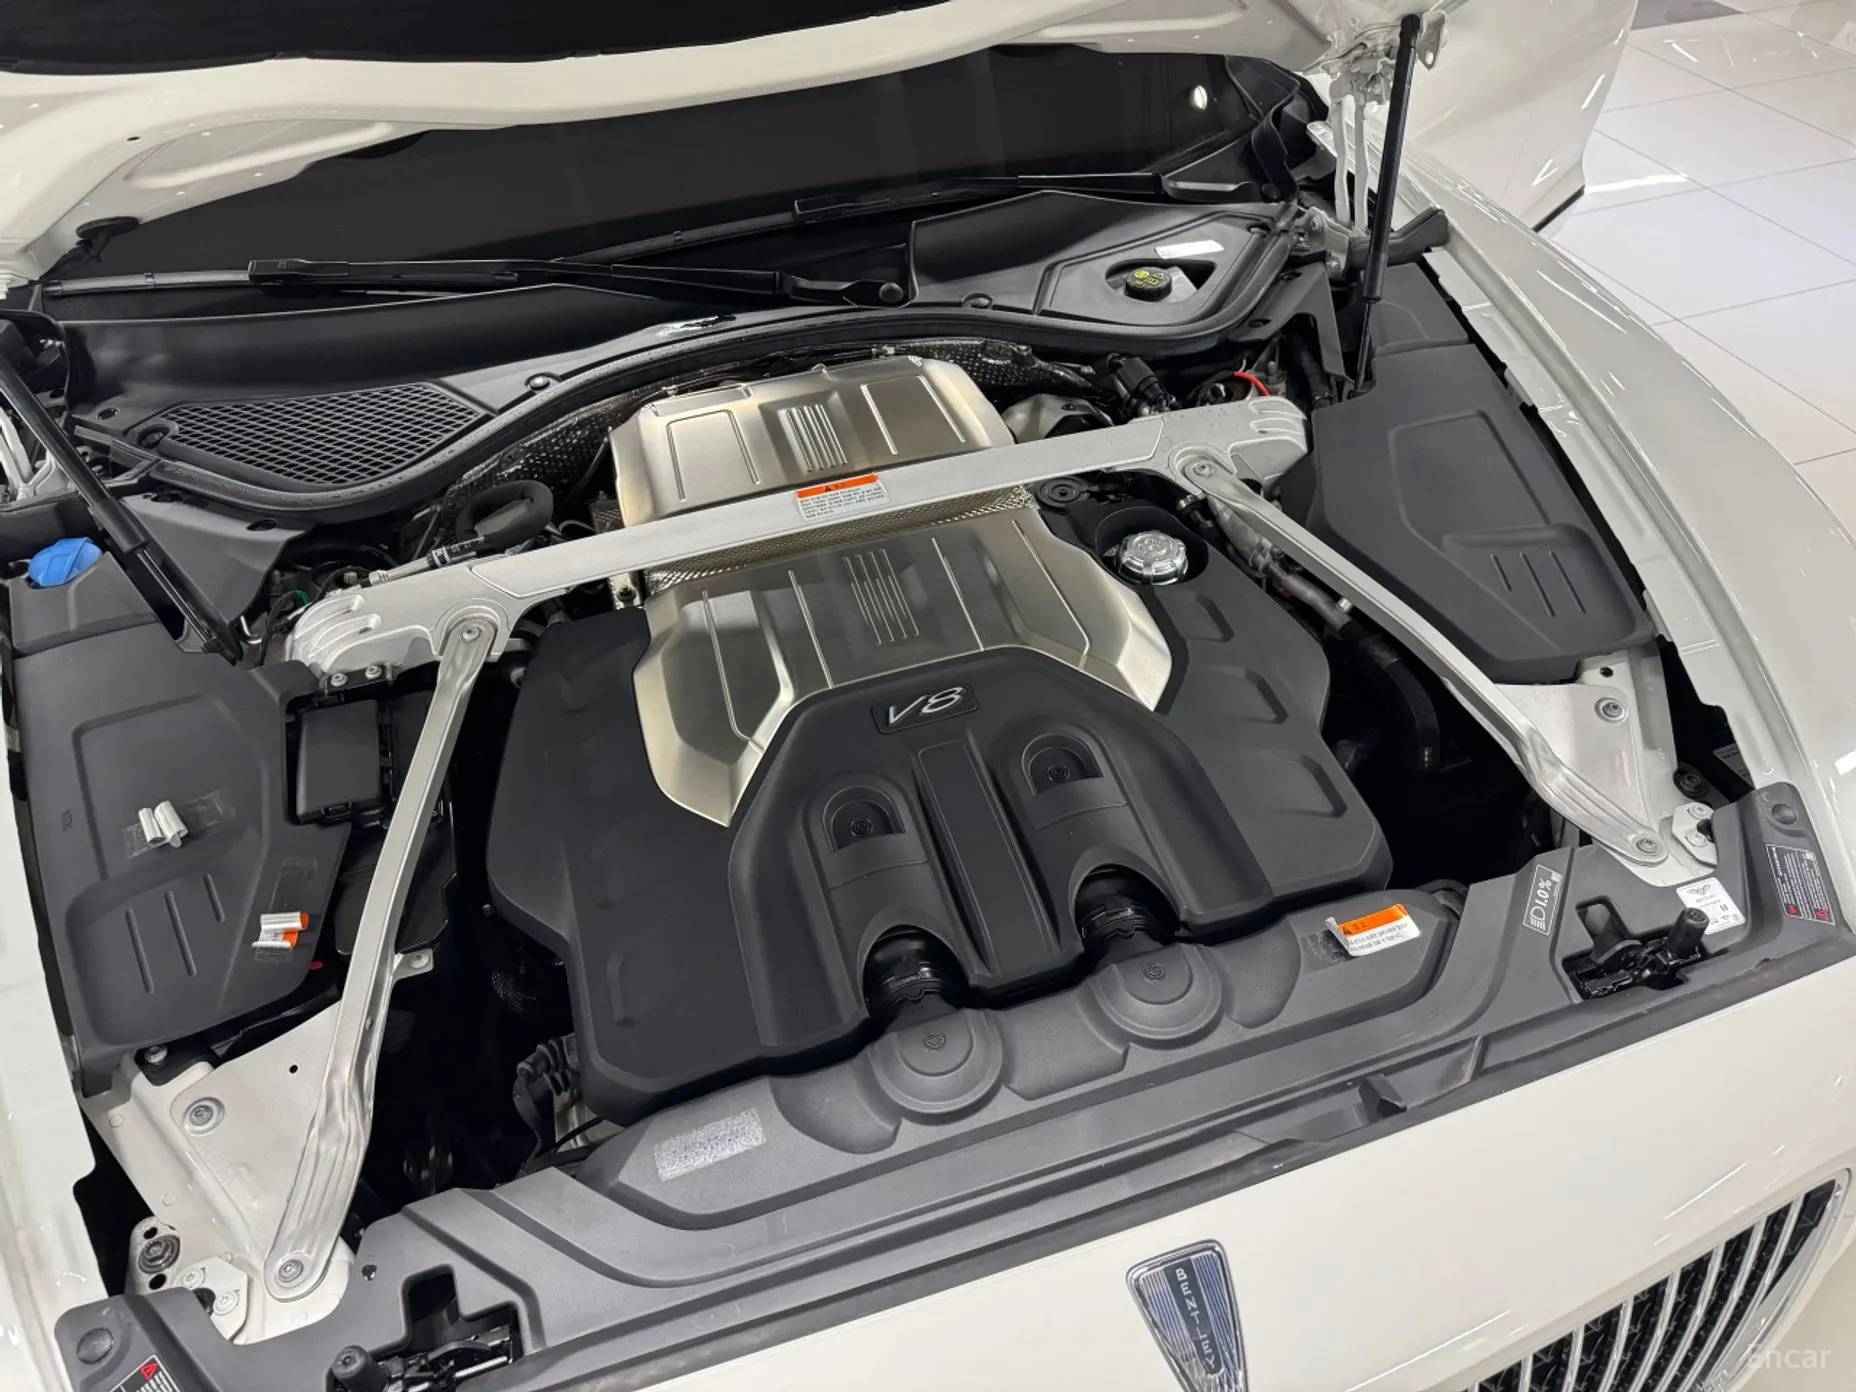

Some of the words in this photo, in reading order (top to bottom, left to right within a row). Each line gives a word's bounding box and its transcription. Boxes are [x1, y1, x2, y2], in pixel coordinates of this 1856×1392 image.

[889, 686, 964, 725] V8
[1534, 877, 1553, 907] 1.0%
[1175, 1267, 1216, 1369] BENTLEY
